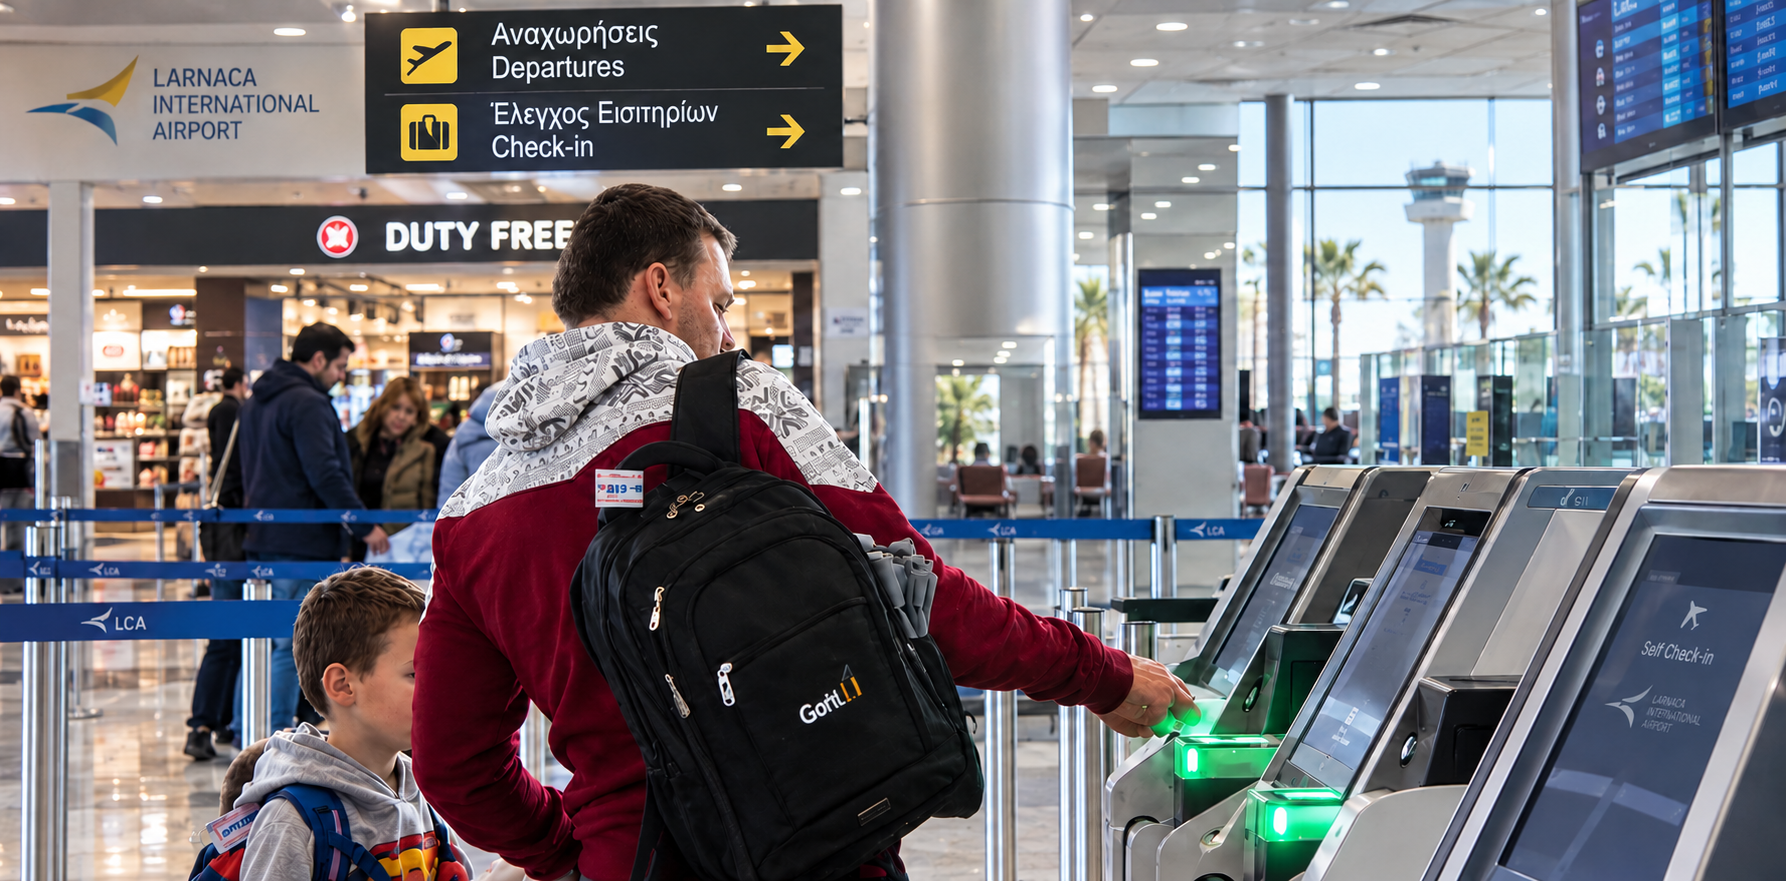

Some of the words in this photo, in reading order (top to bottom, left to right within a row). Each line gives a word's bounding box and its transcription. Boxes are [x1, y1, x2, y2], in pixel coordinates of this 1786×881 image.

[491, 20, 659, 51] Αναχωρήσεις
[153, 67, 257, 88] LARNACA
[492, 55, 625, 85] Departures
[153, 93, 320, 114] INTERNATIONAL
[490, 101, 590, 130] Έλεγχος
[598, 99, 719, 129] Εισιτηρίων
[152, 121, 243, 140] AIRPORT
[491, 134, 594, 159] Check-in
[385, 221, 480, 252] DUTY
[490, 219, 575, 251] FREE
[1206, 525, 1225, 537] LCA
[103, 566, 120, 576] LCA
[115, 616, 147, 631] LCA
[1641, 640, 1666, 658] Self
[1664, 643, 1715, 666] Check-in
